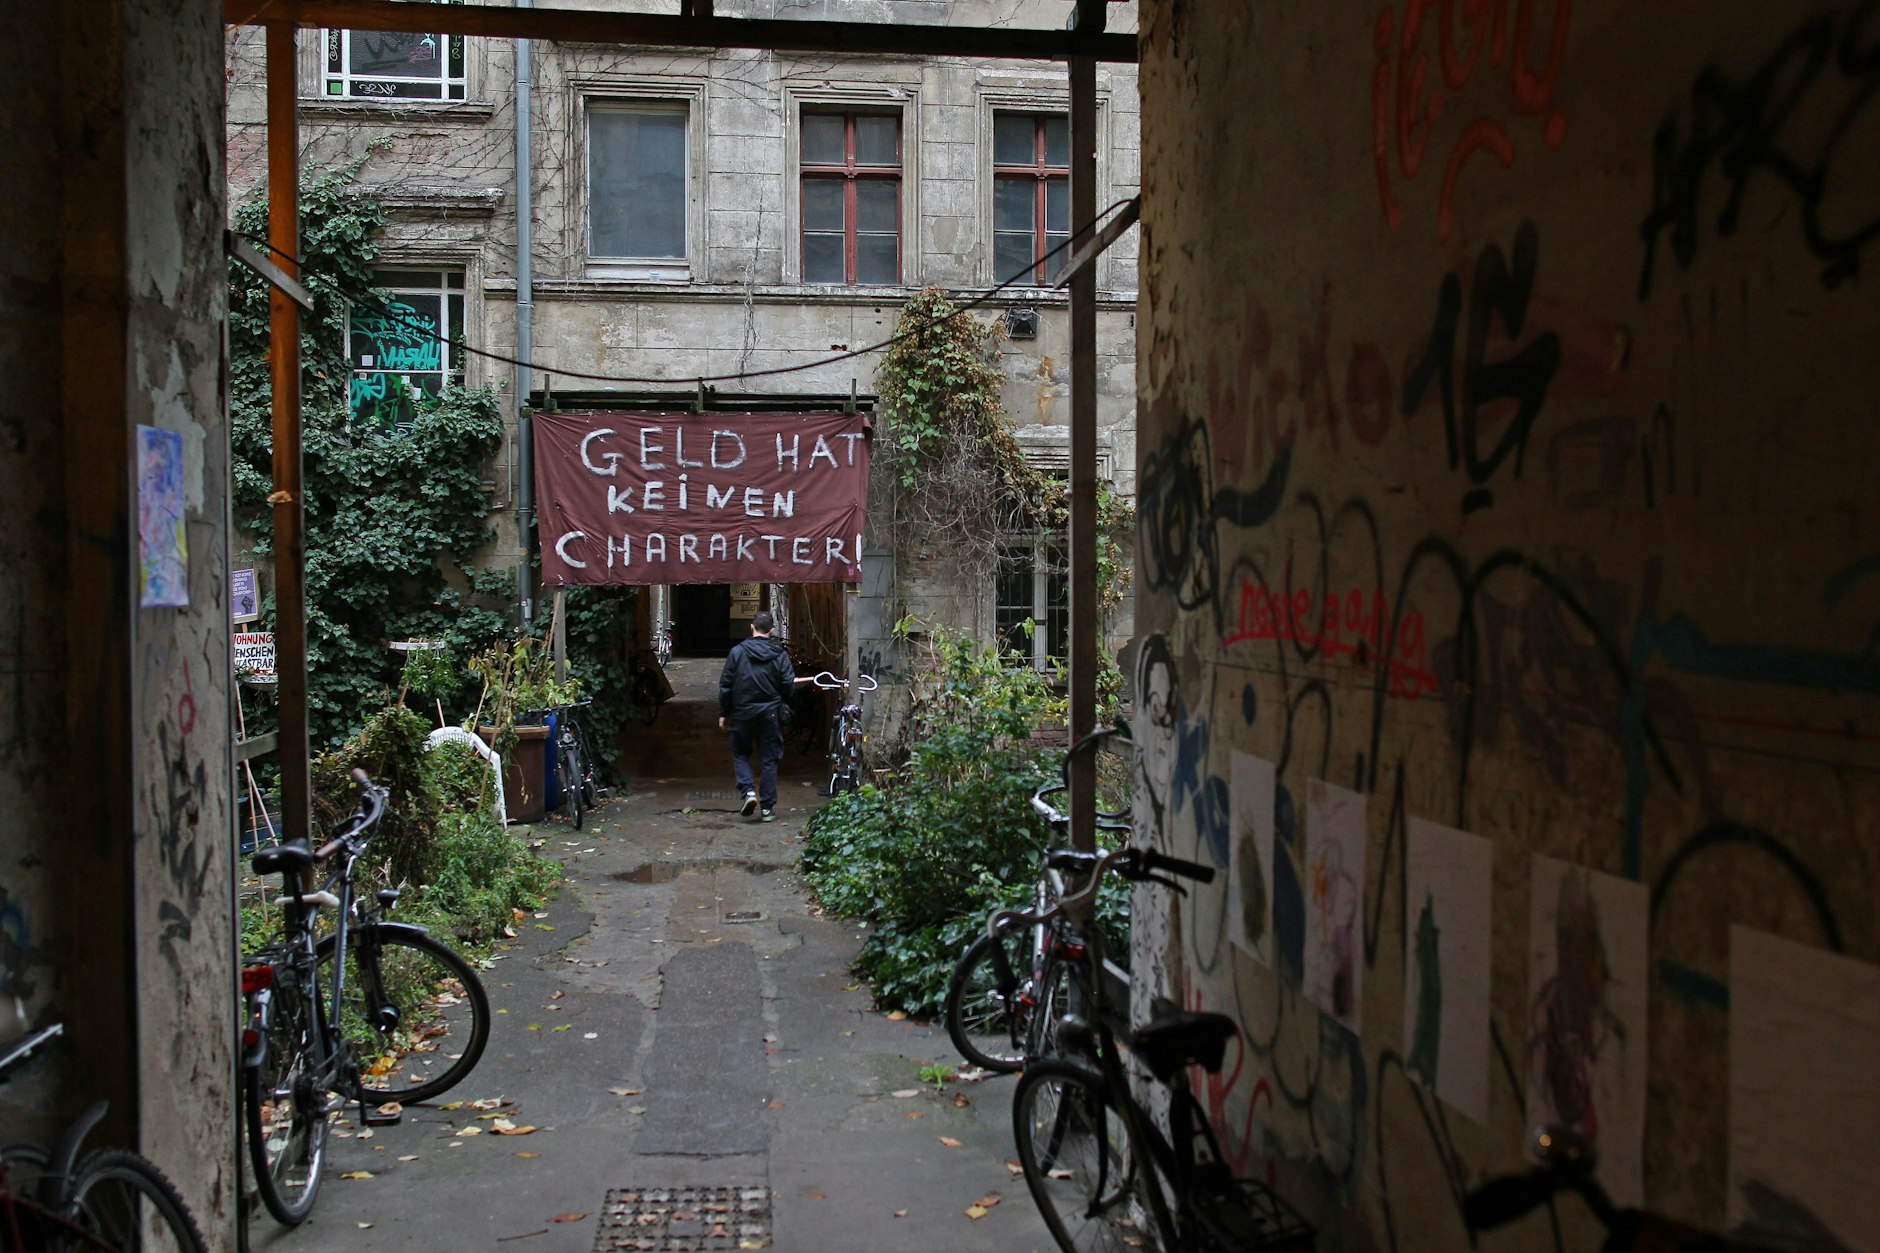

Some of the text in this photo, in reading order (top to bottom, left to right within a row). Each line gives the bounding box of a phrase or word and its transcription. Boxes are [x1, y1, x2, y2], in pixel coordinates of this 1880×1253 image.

[580, 426, 865, 477] GELD HAT
[555, 530, 863, 573] CHARAKTER!
[234, 646, 274, 658] ENSCHEN
